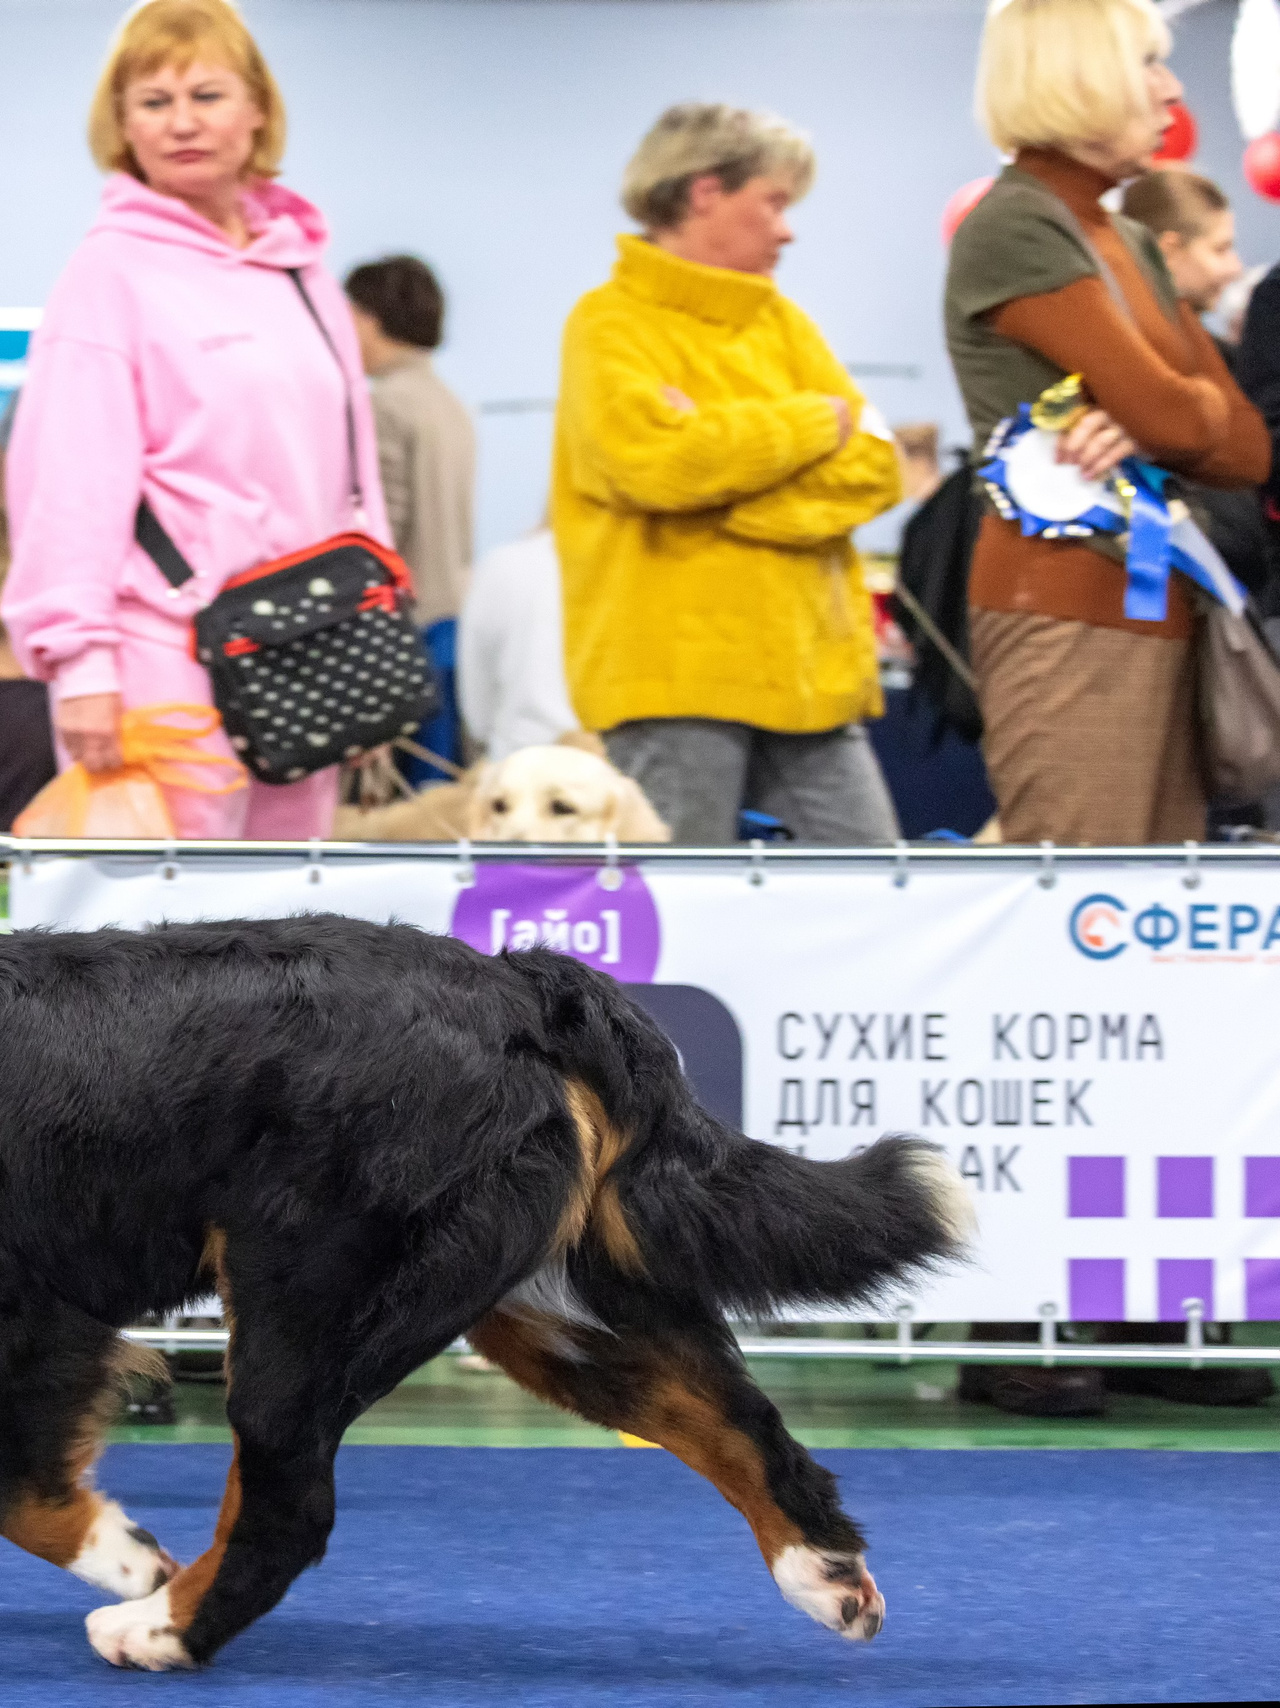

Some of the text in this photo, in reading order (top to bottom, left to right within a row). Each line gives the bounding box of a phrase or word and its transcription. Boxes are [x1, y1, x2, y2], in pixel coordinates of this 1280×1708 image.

[776, 1012, 1165, 1061] СУХИЕ КОРМА
[775, 1078, 1093, 1135] ДЛЯ КОШЕК
